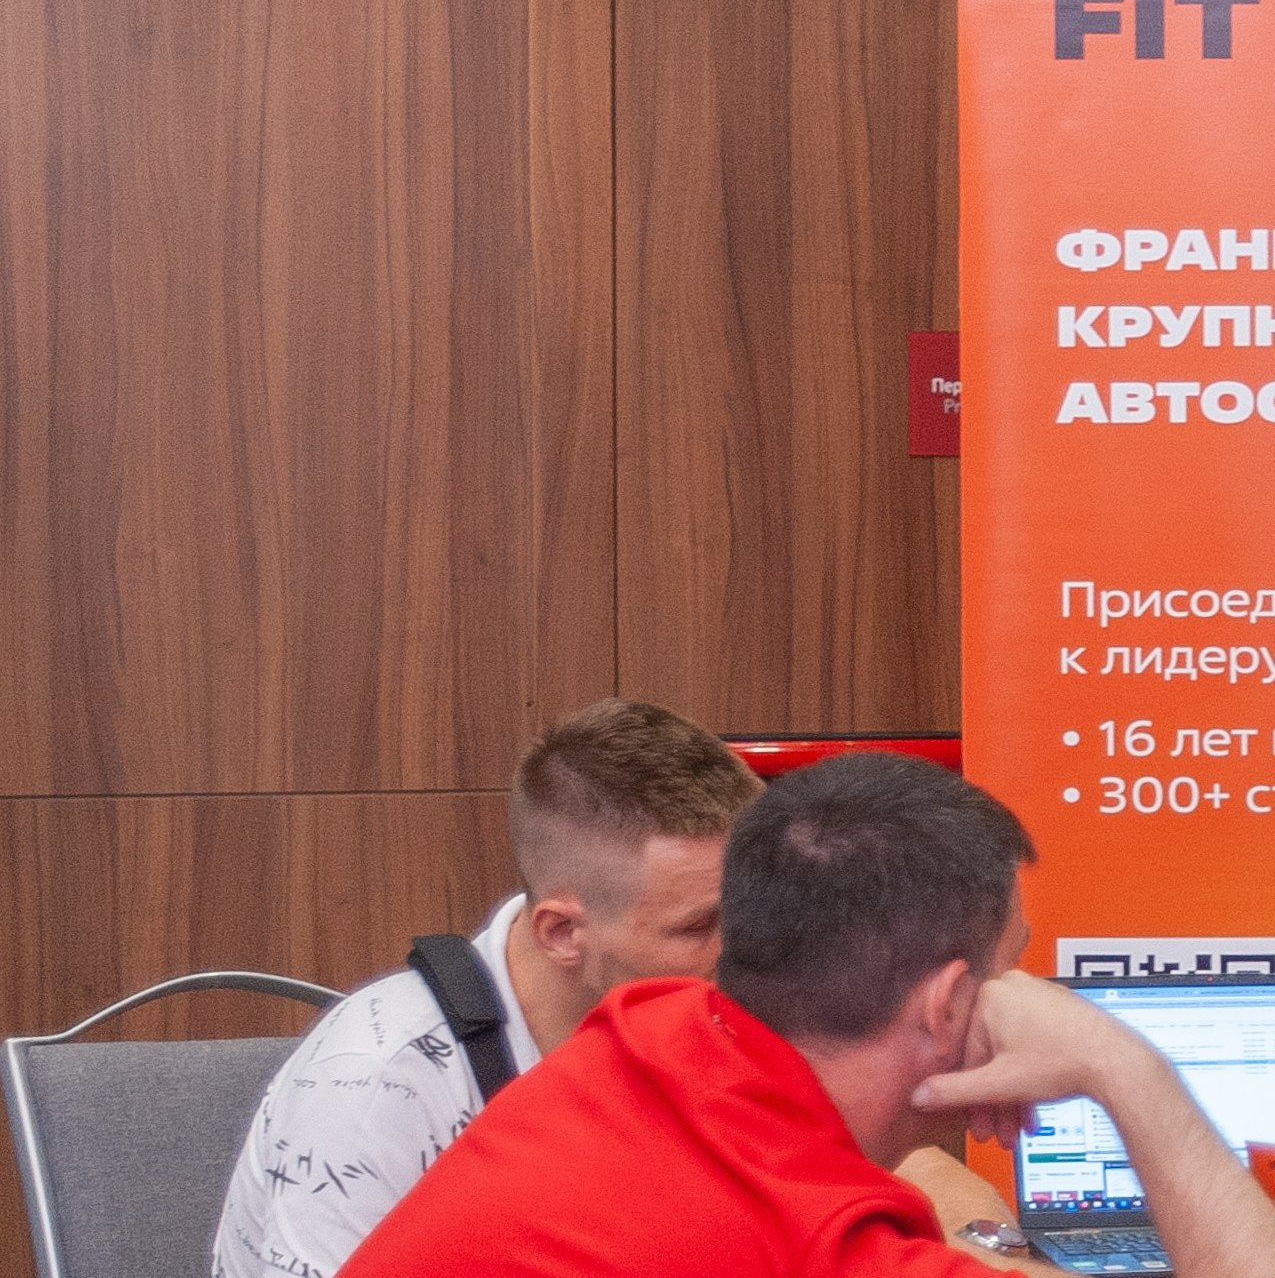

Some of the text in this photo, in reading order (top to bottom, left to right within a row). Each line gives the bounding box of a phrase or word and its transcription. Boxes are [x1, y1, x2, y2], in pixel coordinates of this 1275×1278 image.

[1060, 647, 1087, 674] к
[1099, 719, 1156, 757] 16
[1170, 728, 1258, 757] лет
[1099, 776, 1230, 814] 300+
